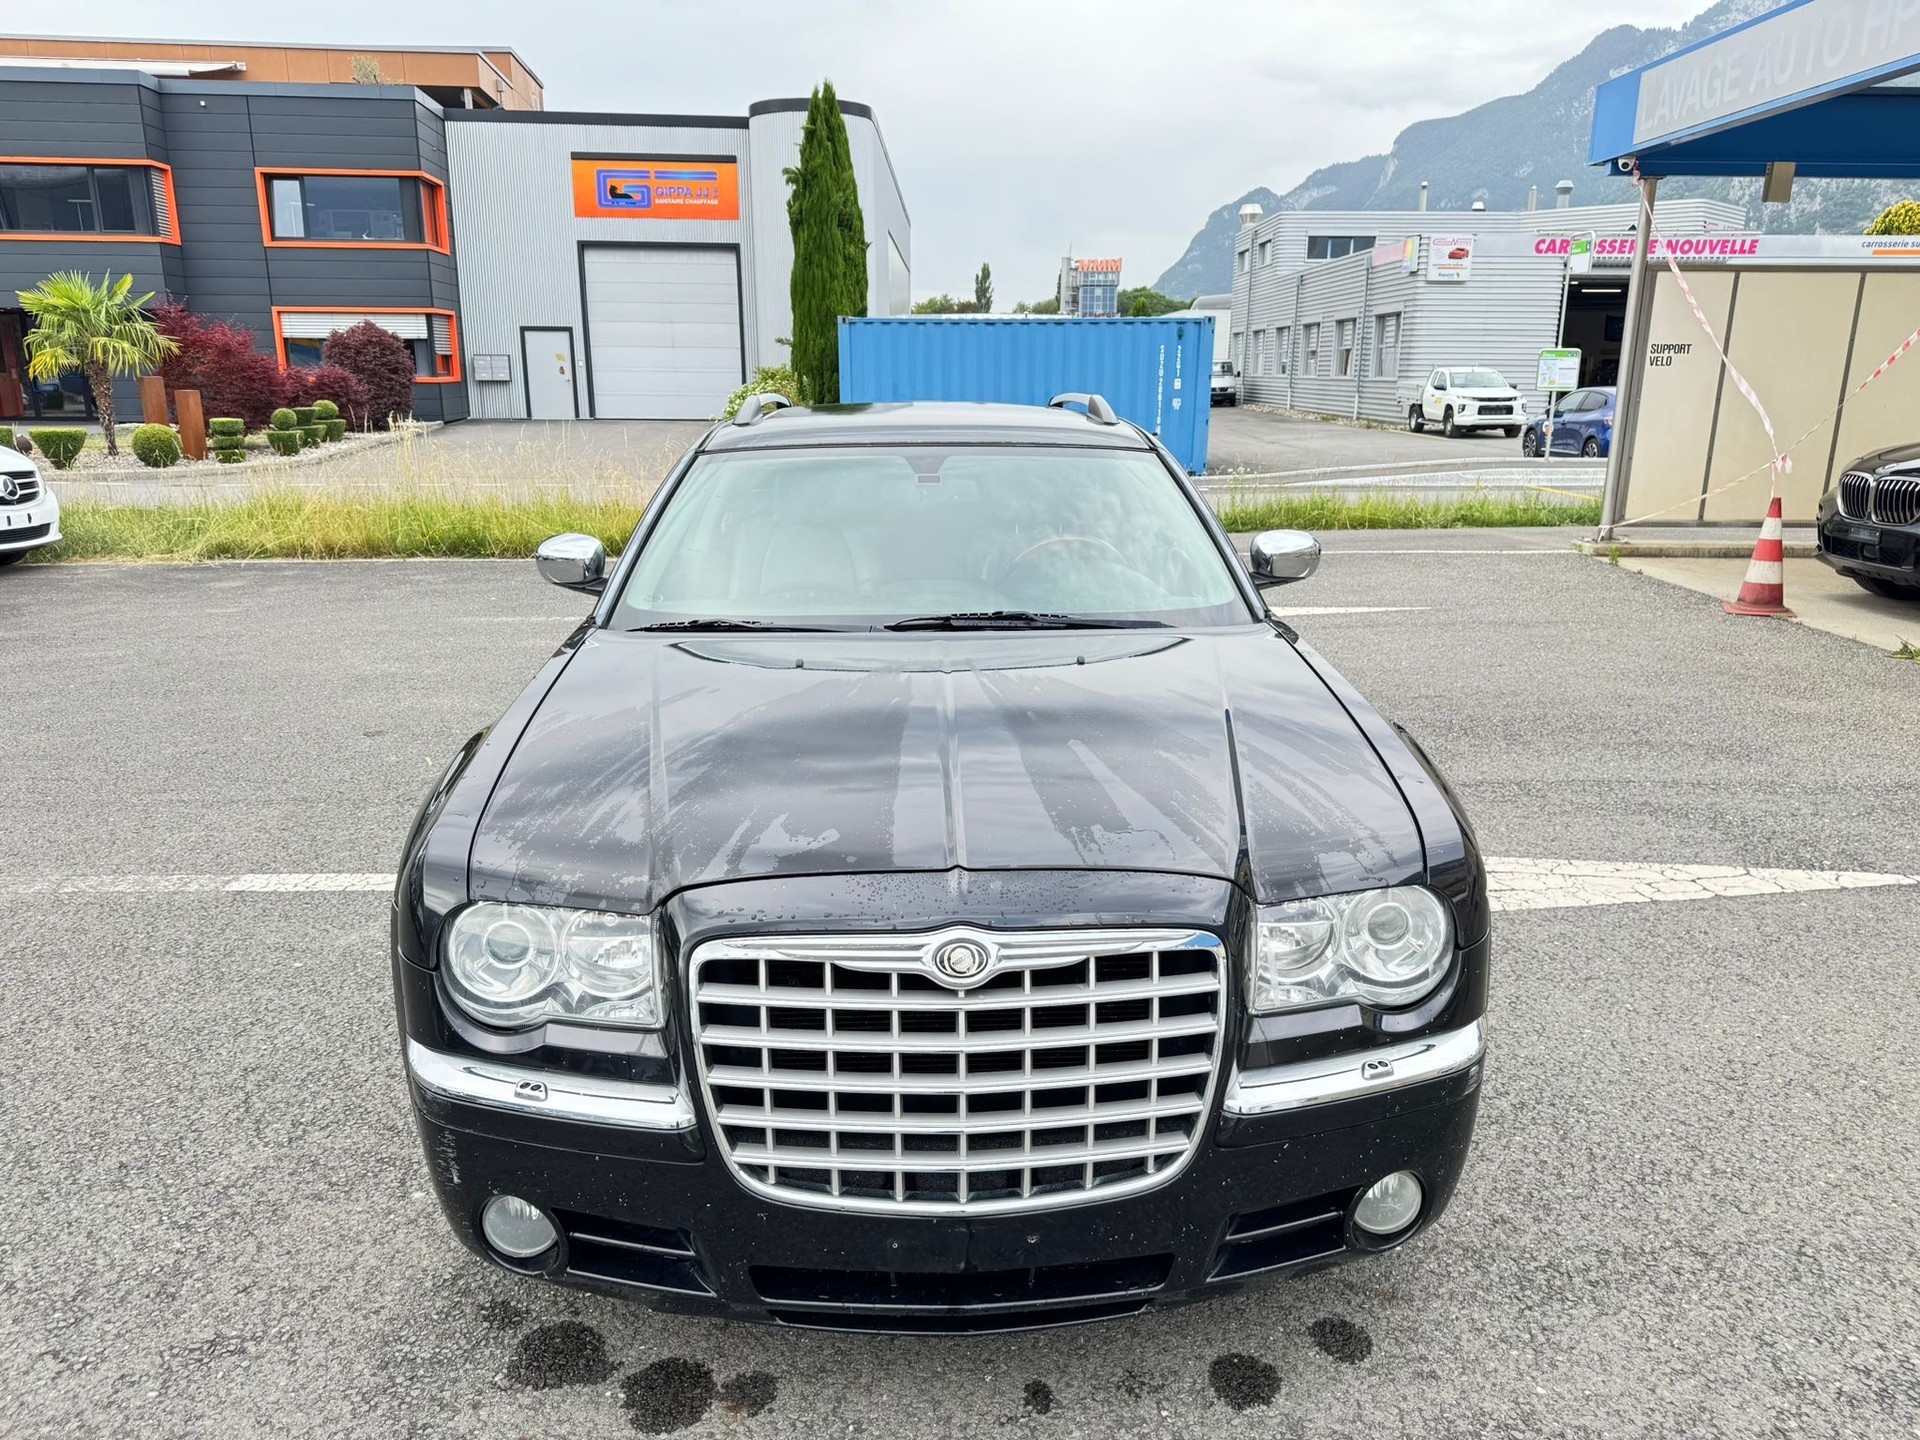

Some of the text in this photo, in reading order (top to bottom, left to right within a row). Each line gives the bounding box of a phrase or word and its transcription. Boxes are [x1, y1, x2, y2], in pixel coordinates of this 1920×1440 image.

[1640, 48, 1745, 131] LAVAGE
[1750, 11, 1851, 93] AUTO
[1665, 238, 1759, 255] NOUVELLE
[1861, 240, 1909, 248] carrosserie
[1650, 343, 1692, 354] SUPPORT
[1649, 355, 1672, 366] VELO
